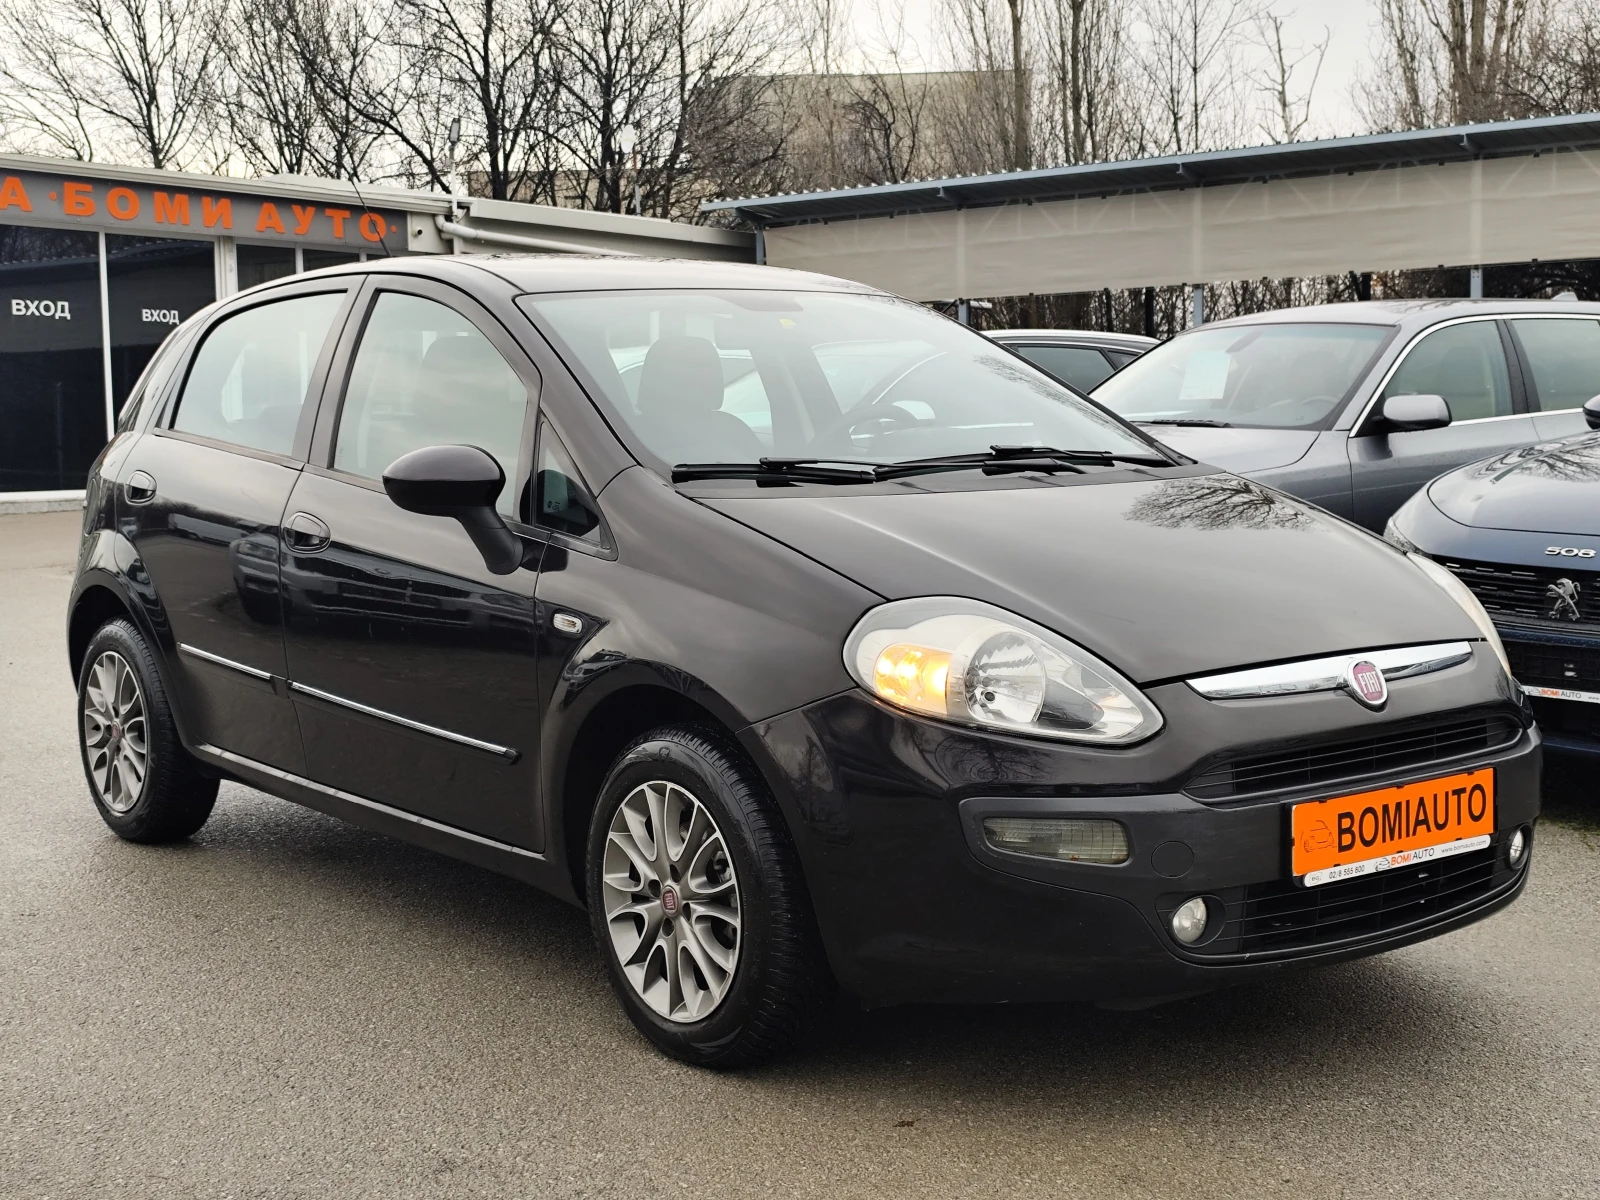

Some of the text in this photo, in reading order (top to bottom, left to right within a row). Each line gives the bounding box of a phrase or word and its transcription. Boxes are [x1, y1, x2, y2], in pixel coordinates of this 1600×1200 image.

[63, 181, 233, 230] БОМИ
[255, 202, 387, 242] АУТО
[11, 298, 71, 320] ВХОД
[141, 309, 180, 325] ВХОД
[1544, 546, 1597, 558] 508
[1357, 671, 1382, 694] FIAT
[1541, 688, 1560, 697] BOMI
[1560, 691, 1582, 699] AUTO
[1337, 783, 1487, 853] BOMIAUTO
[1441, 840, 1487, 854] www.bomiauto.com
[1390, 847, 1435, 866] BOMI AUTO
[1343, 867, 1354, 877] 555
[1355, 864, 1366, 874] 800
